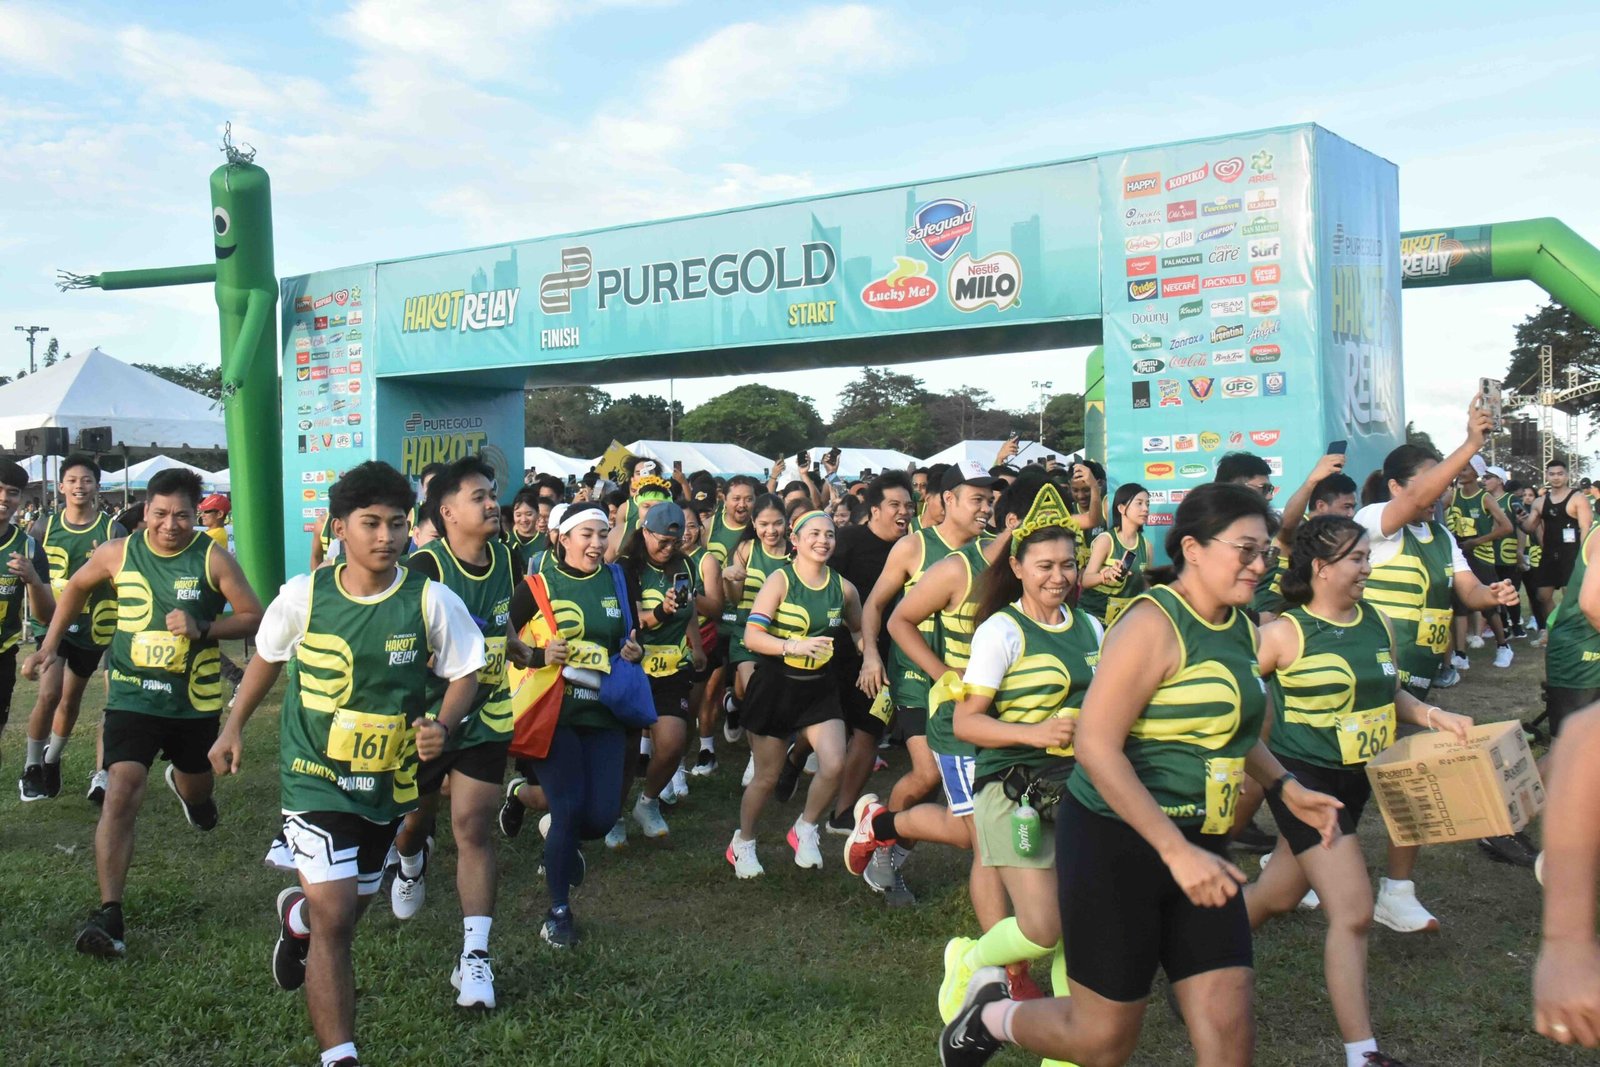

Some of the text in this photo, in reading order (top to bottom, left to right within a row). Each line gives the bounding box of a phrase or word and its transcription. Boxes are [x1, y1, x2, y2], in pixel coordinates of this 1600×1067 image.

[1126, 178, 1157, 192] HAPPY
[1169, 169, 1205, 189] KOPIKO
[1248, 174, 1277, 184] ARIEL
[906, 204, 975, 243] Safeguard
[1199, 223, 1235, 241] CHAMPION
[1166, 231, 1192, 248] Calla
[1402, 233, 1446, 255] AKOT
[1208, 248, 1238, 264] care
[1251, 243, 1279, 258] Surf
[1164, 255, 1200, 266] PALMOLIVE
[597, 241, 836, 309] PUREGOLD
[868, 285, 931, 303] Lucky Me!
[955, 273, 1016, 301] MILO
[1132, 279, 1156, 296] Pride
[402, 287, 520, 334] HAKOT RELAY
[788, 300, 836, 326] START
[1211, 300, 1243, 310] CREAM
[1132, 312, 1168, 325] Downy
[540, 327, 580, 351] FINISH
[1247, 320, 1280, 344] Angel
[1170, 335, 1199, 350] Zonrox
[1226, 381, 1253, 391] UFC
[423, 418, 482, 431] PUREGOLD
[177, 589, 201, 600] RELAY
[1427, 624, 1447, 645] 38
[385, 638, 416, 652] HAKOT
[145, 645, 176, 665] 192
[389, 650, 418, 666] RELAY
[483, 652, 503, 675] 28
[650, 657, 667, 672] 34
[352, 732, 388, 760] 161
[1357, 725, 1388, 759] 262
[291, 757, 375, 791] ALWAYS PANALO
[1018, 823, 1031, 852] Sprite
